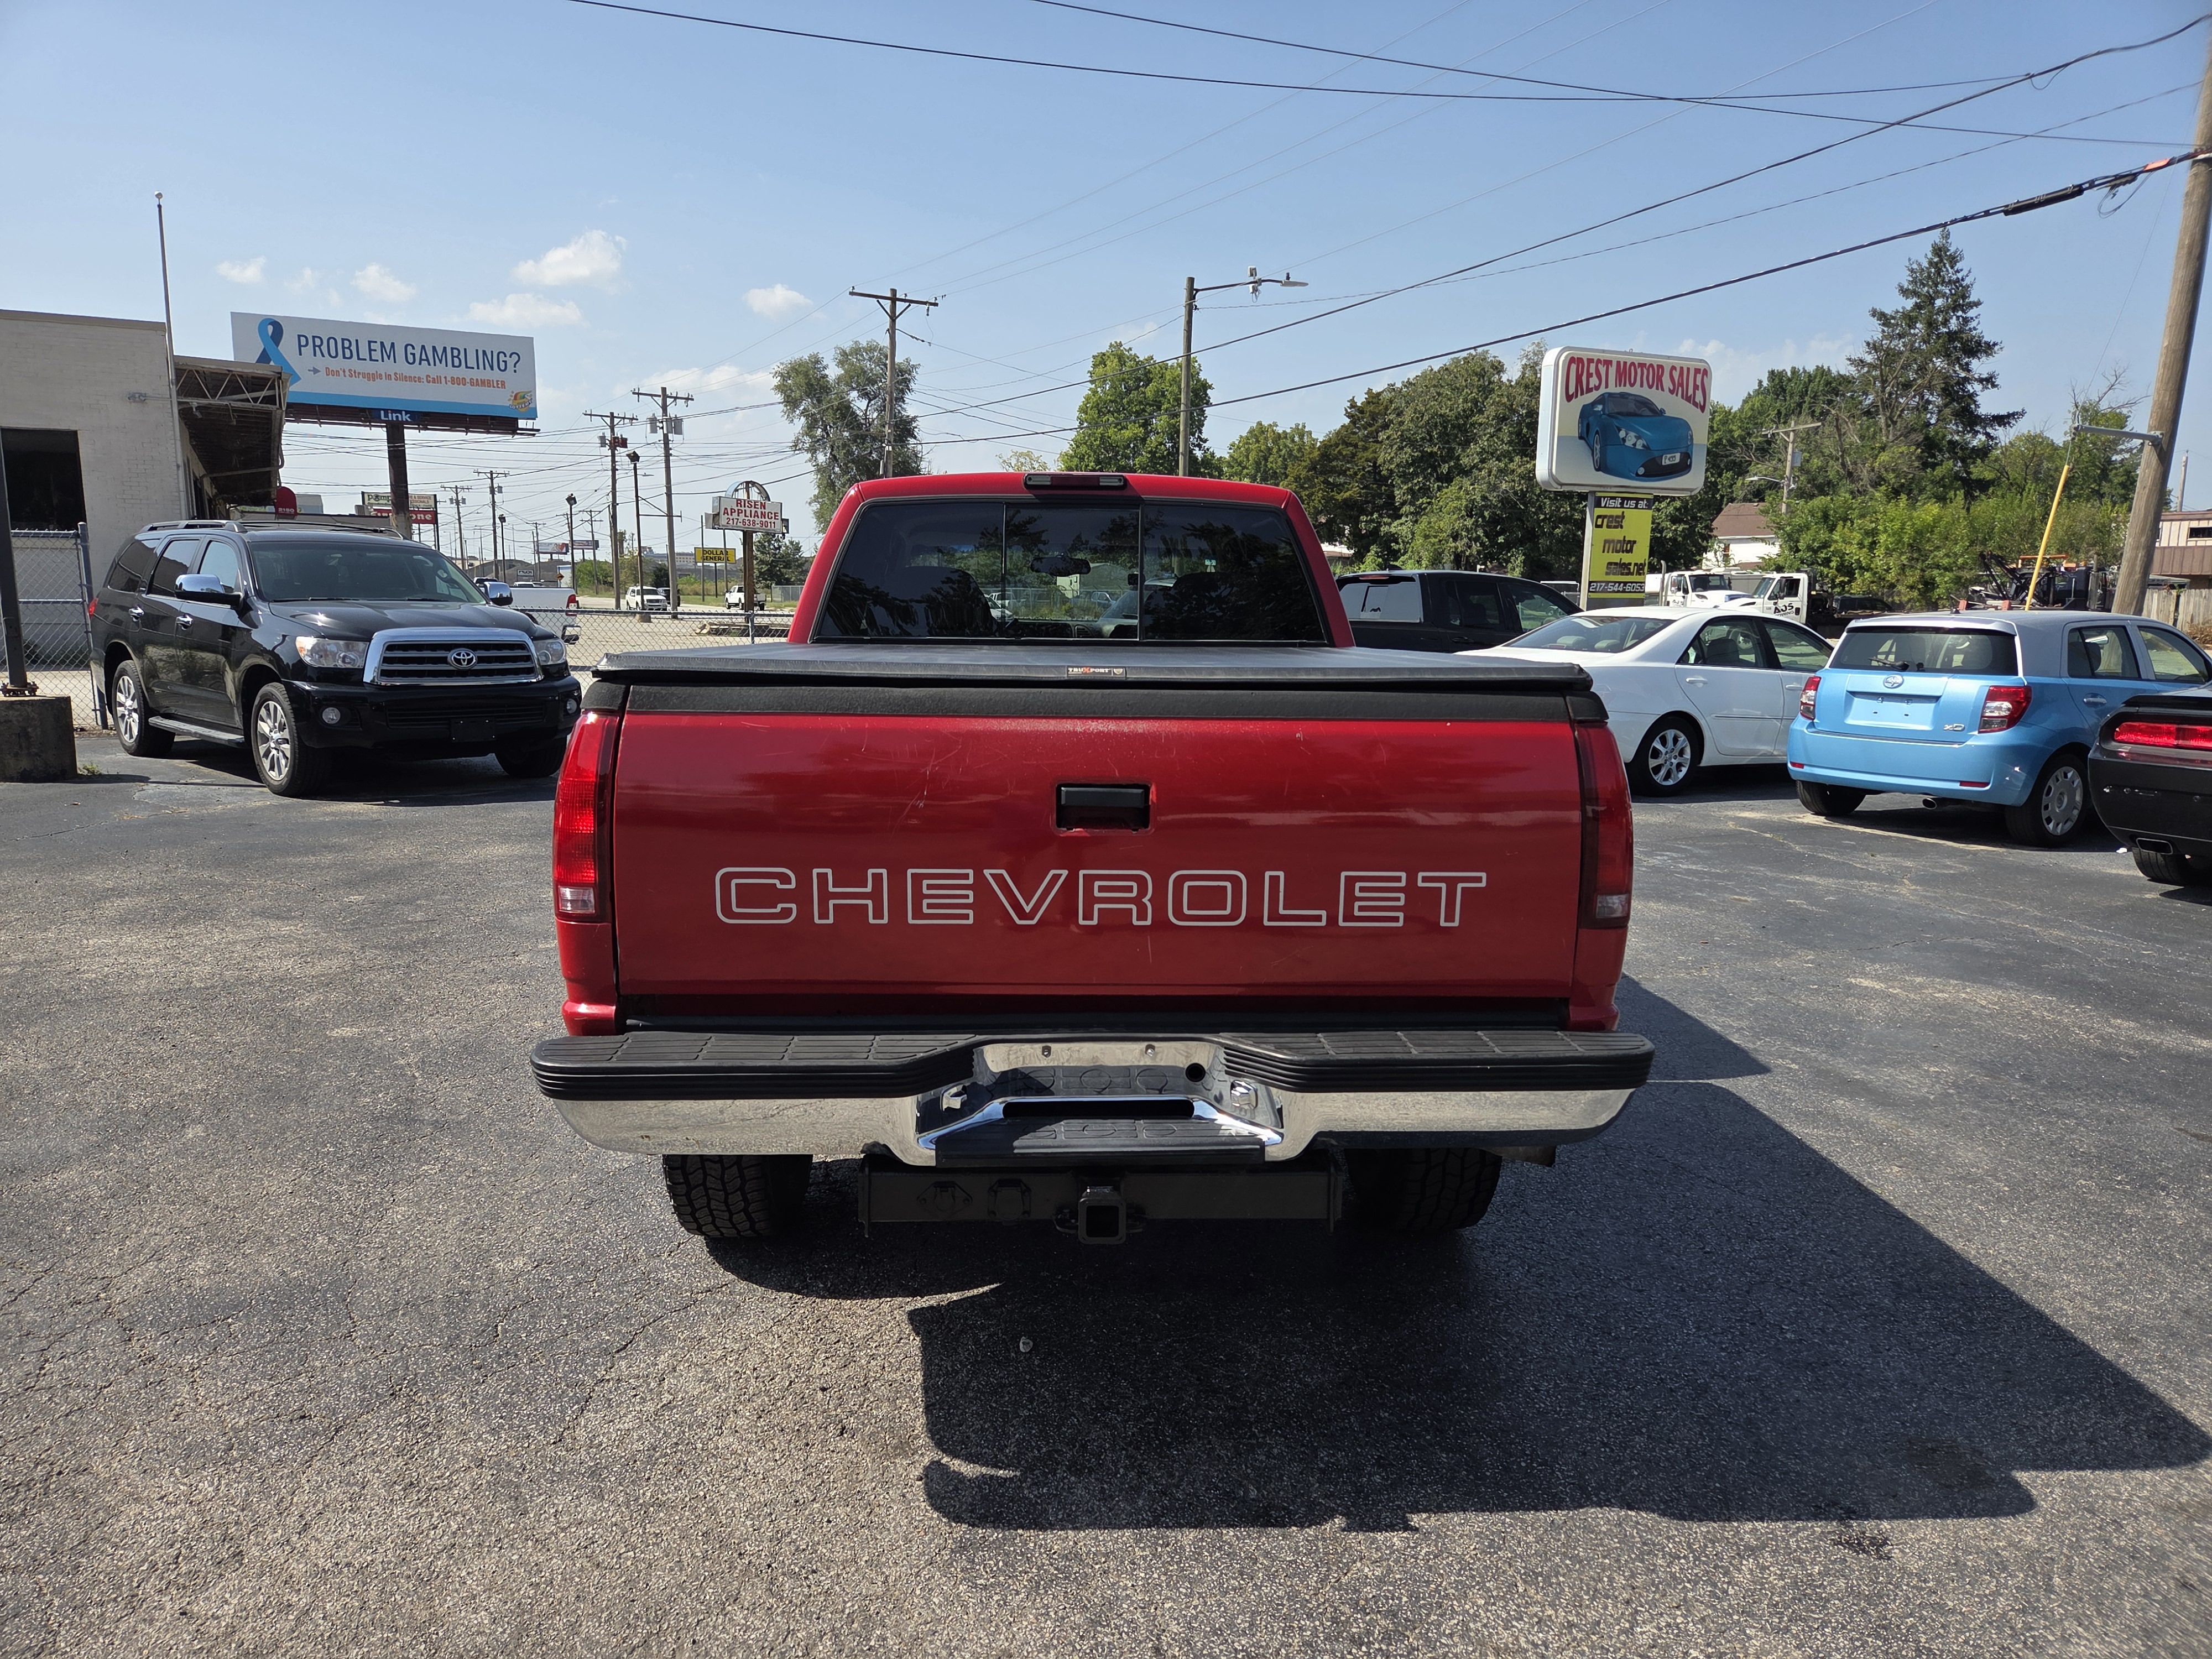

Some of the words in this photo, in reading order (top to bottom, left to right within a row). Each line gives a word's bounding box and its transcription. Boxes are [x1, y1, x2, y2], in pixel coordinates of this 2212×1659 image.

[297, 334, 397, 363] PROBLEM
[404, 343, 520, 373] GAMBLING?
[325, 367, 347, 377] Don't
[348, 369, 383, 382] Struggle
[394, 372, 424, 383] Silence:
[426, 374, 442, 384] Call
[444, 376, 506, 389] 1-800-GAMBLER
[1565, 356, 1613, 403] CREST
[1615, 360, 1665, 392] MOTOR
[1668, 365, 1708, 414] SALES
[380, 410, 411, 421] Link
[736, 499, 766, 510] RISEN
[1601, 497, 1622, 507] Visit
[1624, 500, 1636, 508] us
[1637, 499, 1648, 508] at:
[723, 507, 779, 520] APPLIANCE
[1594, 510, 1625, 529] crest
[726, 517, 776, 528] 217-638-9011
[1602, 535, 1637, 554] motor
[1605, 558, 1646, 576] sales.net
[1589, 583, 1645, 592] 217-544-6053
[1773, 603, 1794, 614] AJS
[716, 867, 1487, 927] CHEVROLET
